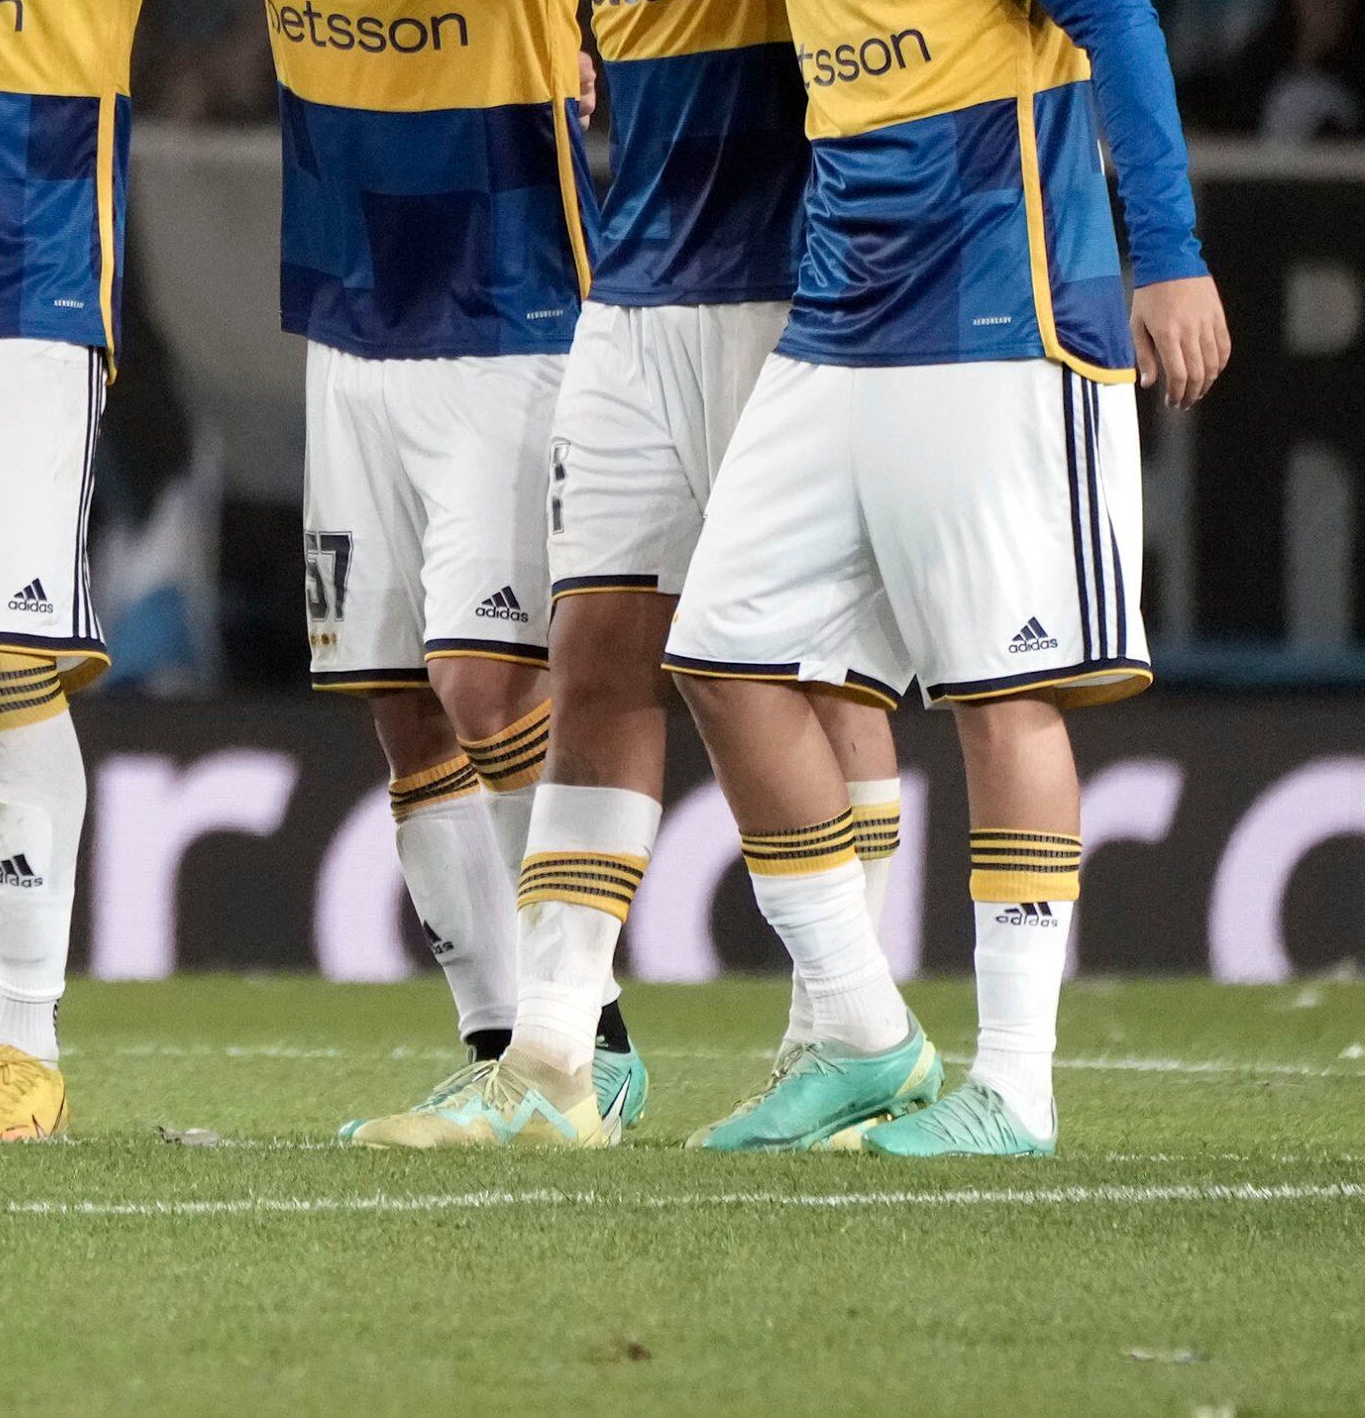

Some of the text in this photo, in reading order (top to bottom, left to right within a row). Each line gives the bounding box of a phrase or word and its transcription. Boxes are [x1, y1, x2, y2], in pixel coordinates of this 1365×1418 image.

[7, 597, 54, 614] adidas
[474, 605, 530, 623] adidas
[1007, 636, 1059, 654] adidas
[994, 912, 1059, 928] adidas
